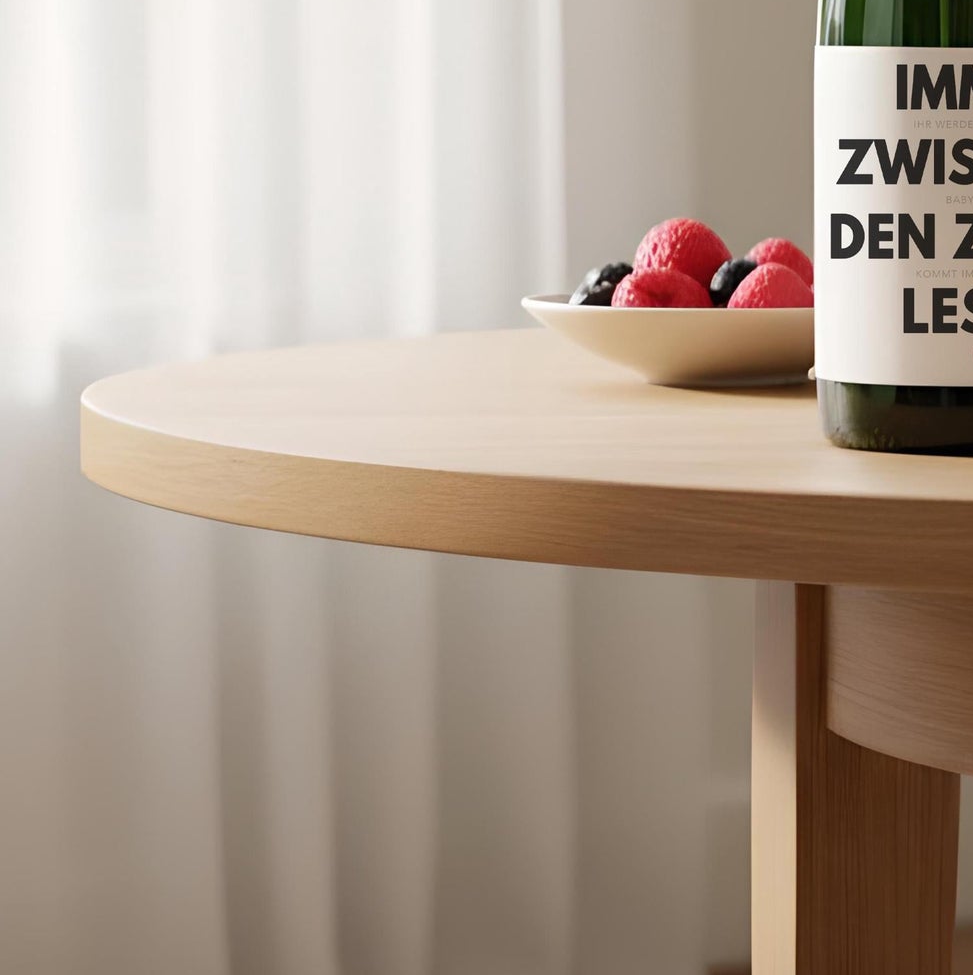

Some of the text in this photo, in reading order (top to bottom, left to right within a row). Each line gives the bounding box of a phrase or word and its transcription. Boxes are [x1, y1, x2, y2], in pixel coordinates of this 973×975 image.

[913, 120, 932, 129] IHR
[945, 195, 973, 204] BABY
[830, 213, 936, 260] DEN
[915, 269, 958, 279] KOMMT
